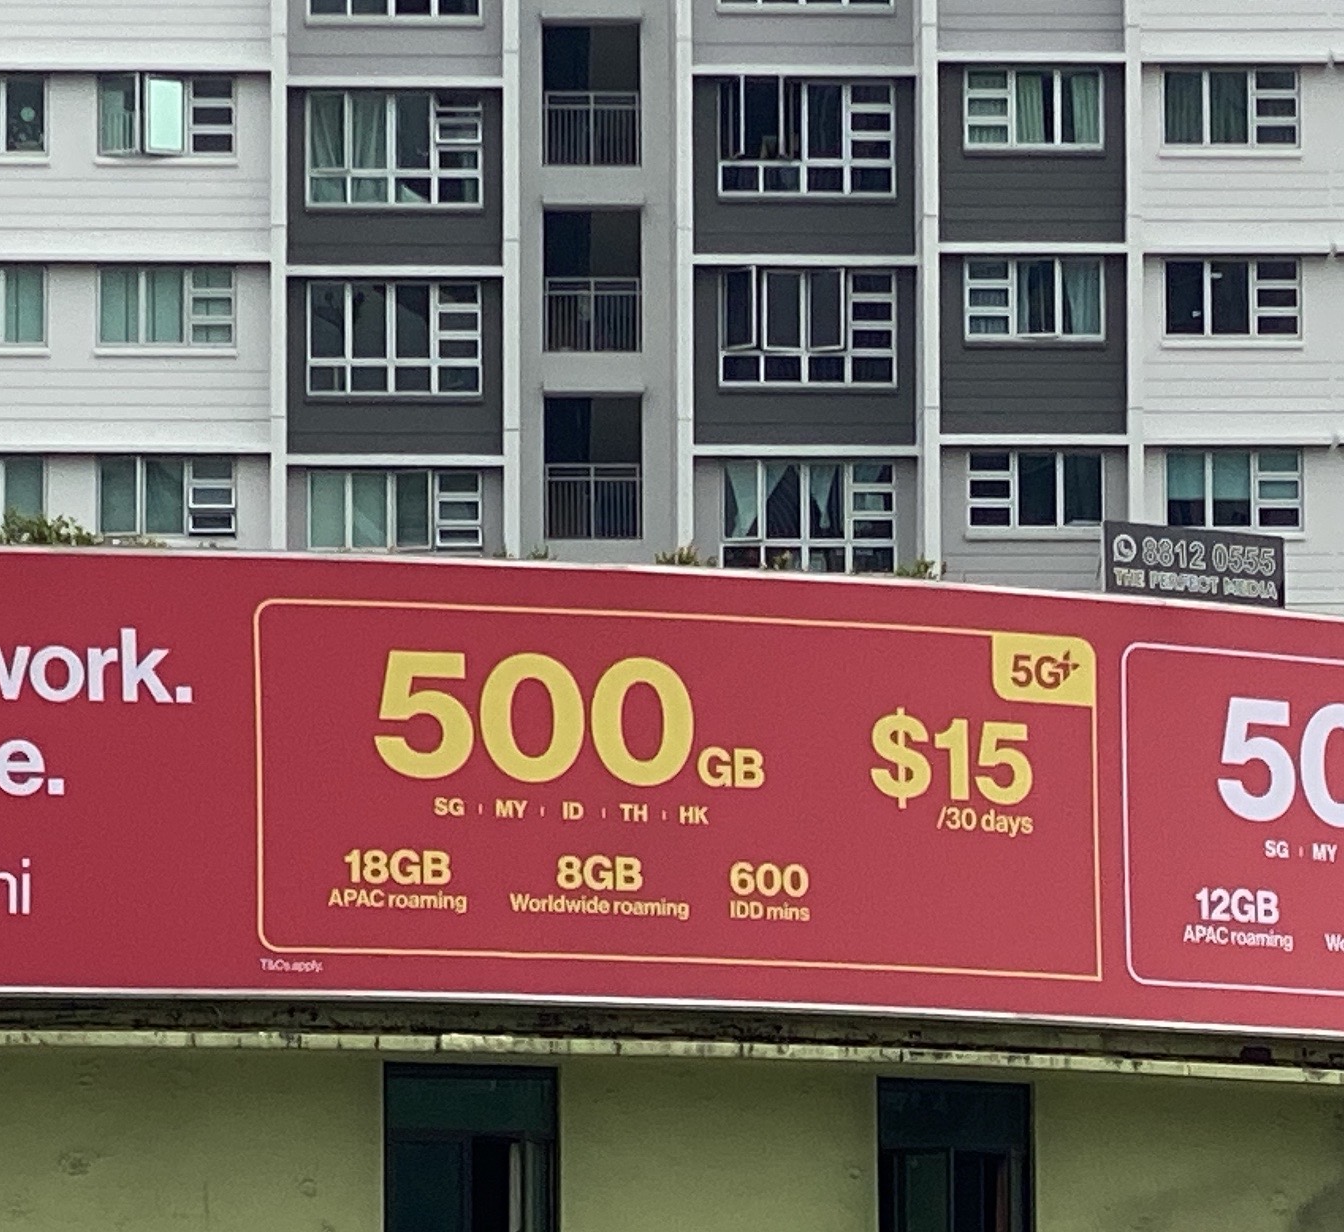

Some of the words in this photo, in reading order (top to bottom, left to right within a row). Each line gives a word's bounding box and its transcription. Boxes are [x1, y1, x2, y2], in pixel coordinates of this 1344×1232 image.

[1142, 536, 1207, 570] 8812
[1211, 543, 1276, 577] 0555
[1113, 567, 1145, 588] THE
[1149, 570, 1219, 595] PERFECT
[1222, 577, 1278, 600] MEDIA
[870, 707, 1034, 810] $15
[433, 796, 465, 817] SG
[495, 799, 528, 820] MY
[562, 801, 584, 821] ID
[619, 803, 649, 823] TH
[679, 805, 710, 826] HK
[937, 806, 976, 832] /30
[980, 808, 1034, 836] days
[343, 848, 452, 886] 18GB
[1264, 840, 1289, 860] SG
[1312, 843, 1338, 863] MY
[556, 855, 644, 892] 8GB
[729, 861, 810, 898] 600
[328, 887, 386, 910] APAC
[387, 890, 468, 914] roaming
[509, 892, 610, 917] Worldwide
[612, 898, 690, 922] roaming
[729, 900, 764, 921] IDD
[766, 901, 811, 922] mins
[1194, 887, 1280, 925] 12GB
[1183, 924, 1229, 945] APAC
[1230, 928, 1294, 952] roaming
